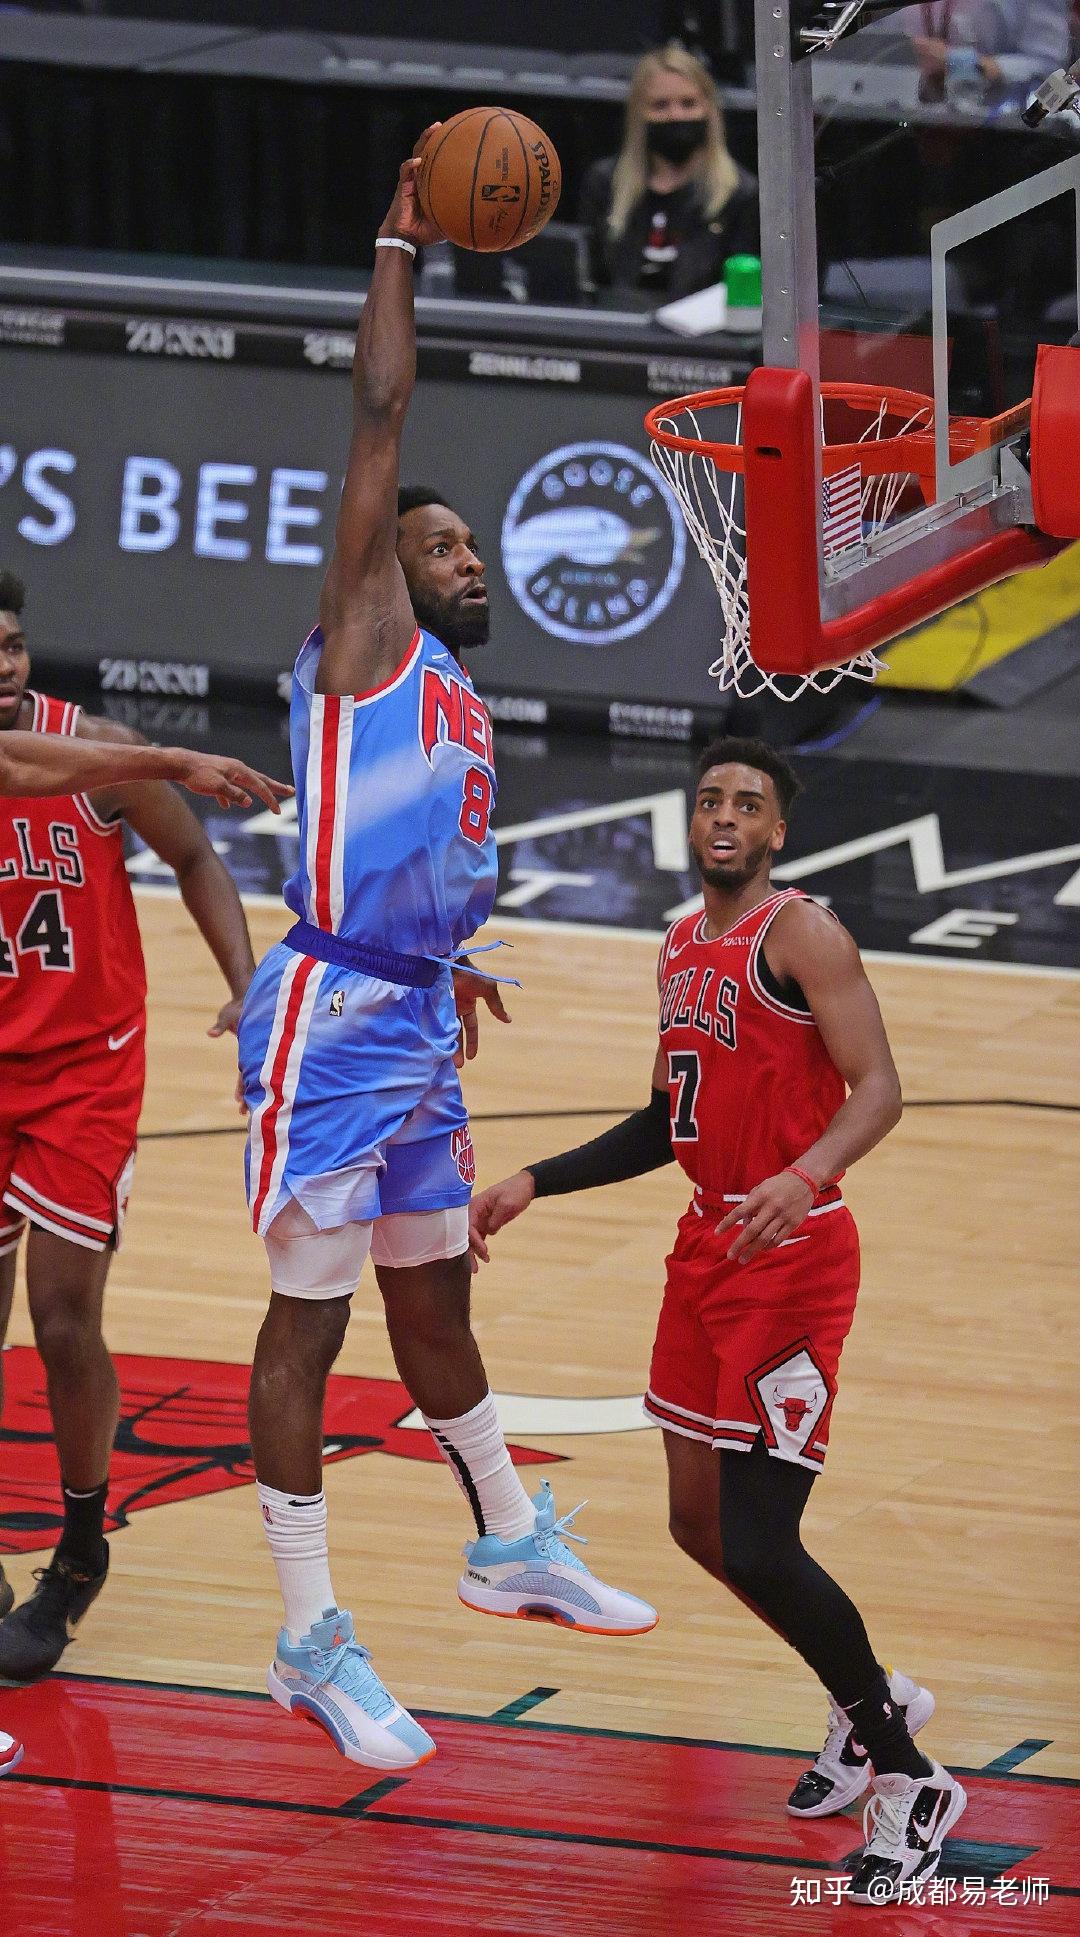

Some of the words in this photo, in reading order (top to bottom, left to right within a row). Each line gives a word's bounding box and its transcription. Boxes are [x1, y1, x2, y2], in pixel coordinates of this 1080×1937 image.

[118, 456, 331, 566] BEE
[458, 765, 492, 847] 8
[659, 966, 740, 1051] ULLS
[667, 1050, 702, 1142] 7
